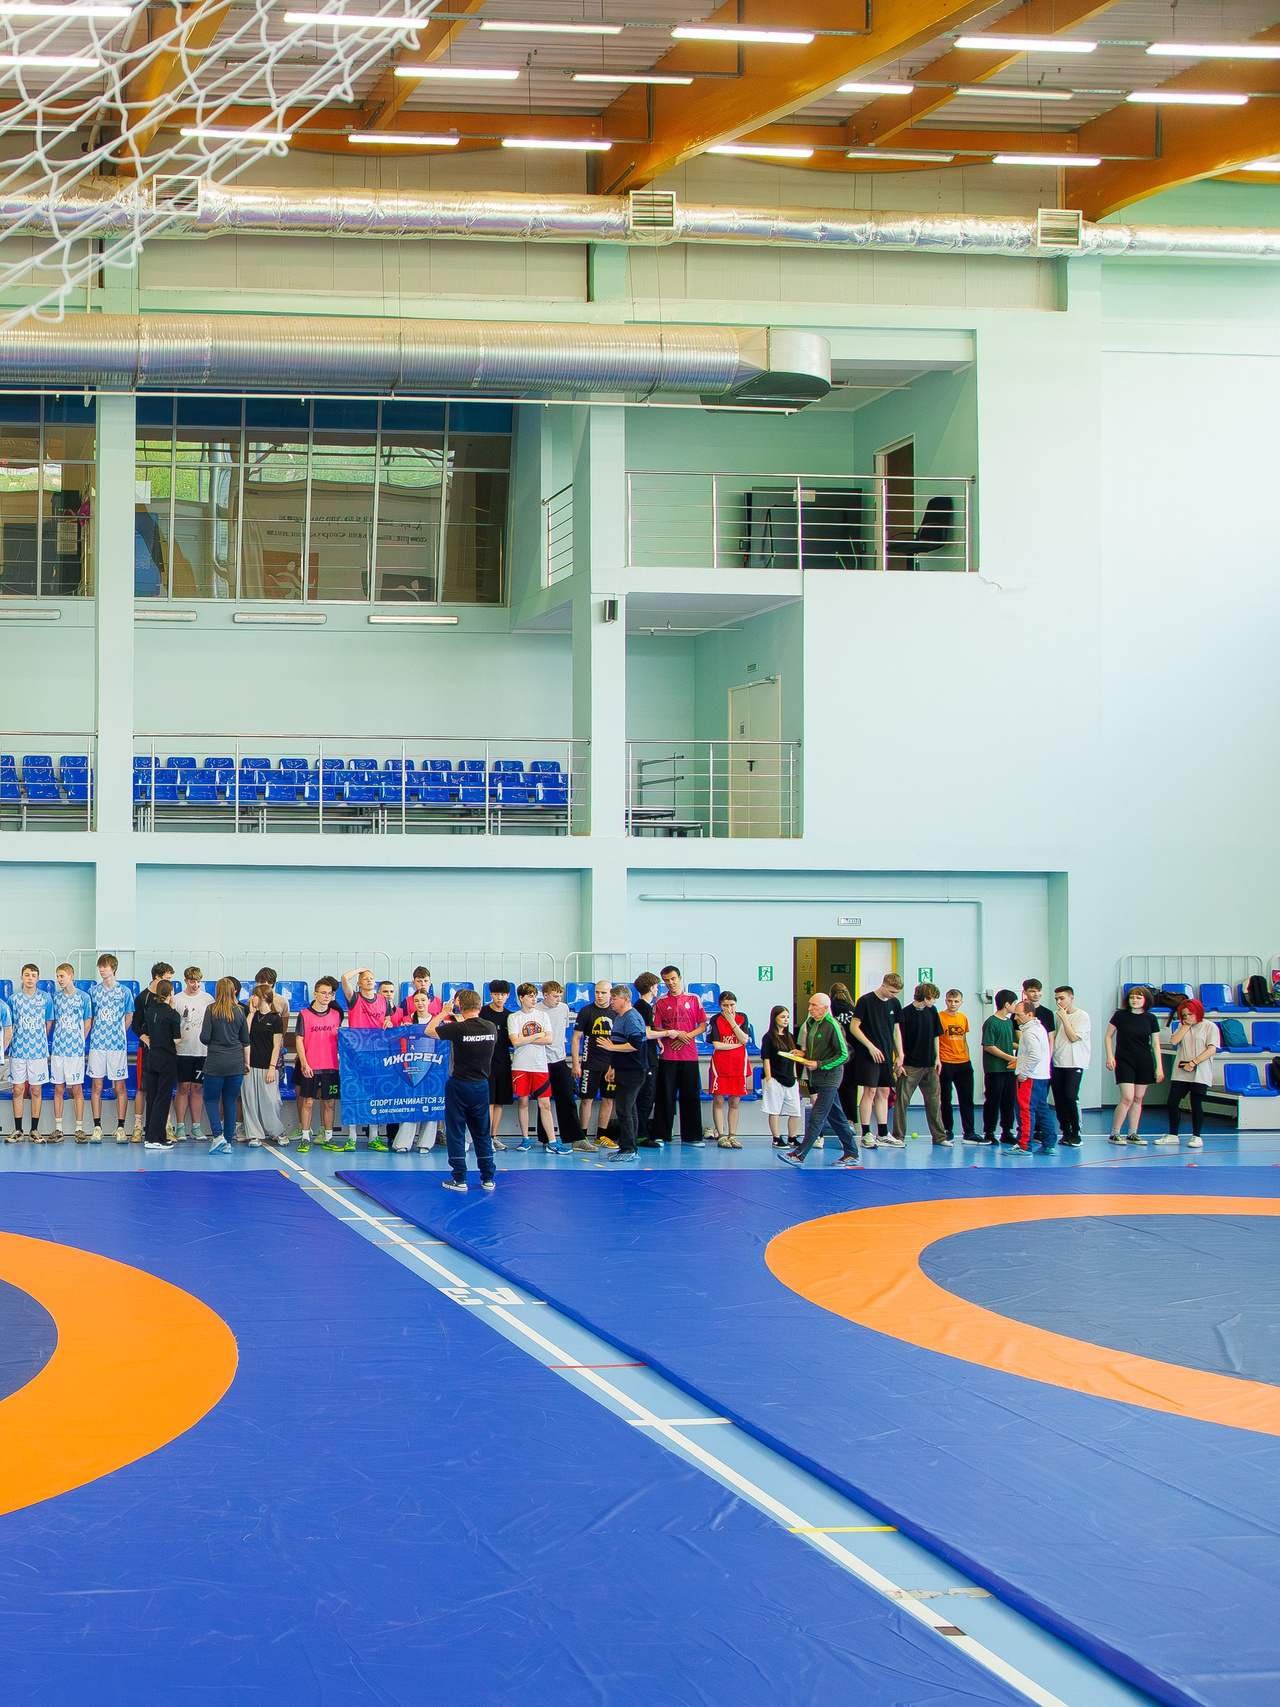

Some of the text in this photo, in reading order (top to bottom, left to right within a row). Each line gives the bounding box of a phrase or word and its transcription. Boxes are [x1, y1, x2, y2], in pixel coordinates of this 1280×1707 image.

[463, 1034, 495, 1042] ИЖОРЕЦ
[383, 1052, 443, 1067] ИЖОРЕЦ
[72, 1073, 81, 1081] 19
[116, 1068, 126, 1078] 52
[329, 1085, 338, 1095] 25
[370, 1098, 393, 1107] СПОРТ
[393, 1096, 437, 1106] НАЧИНАЕТСЯ
